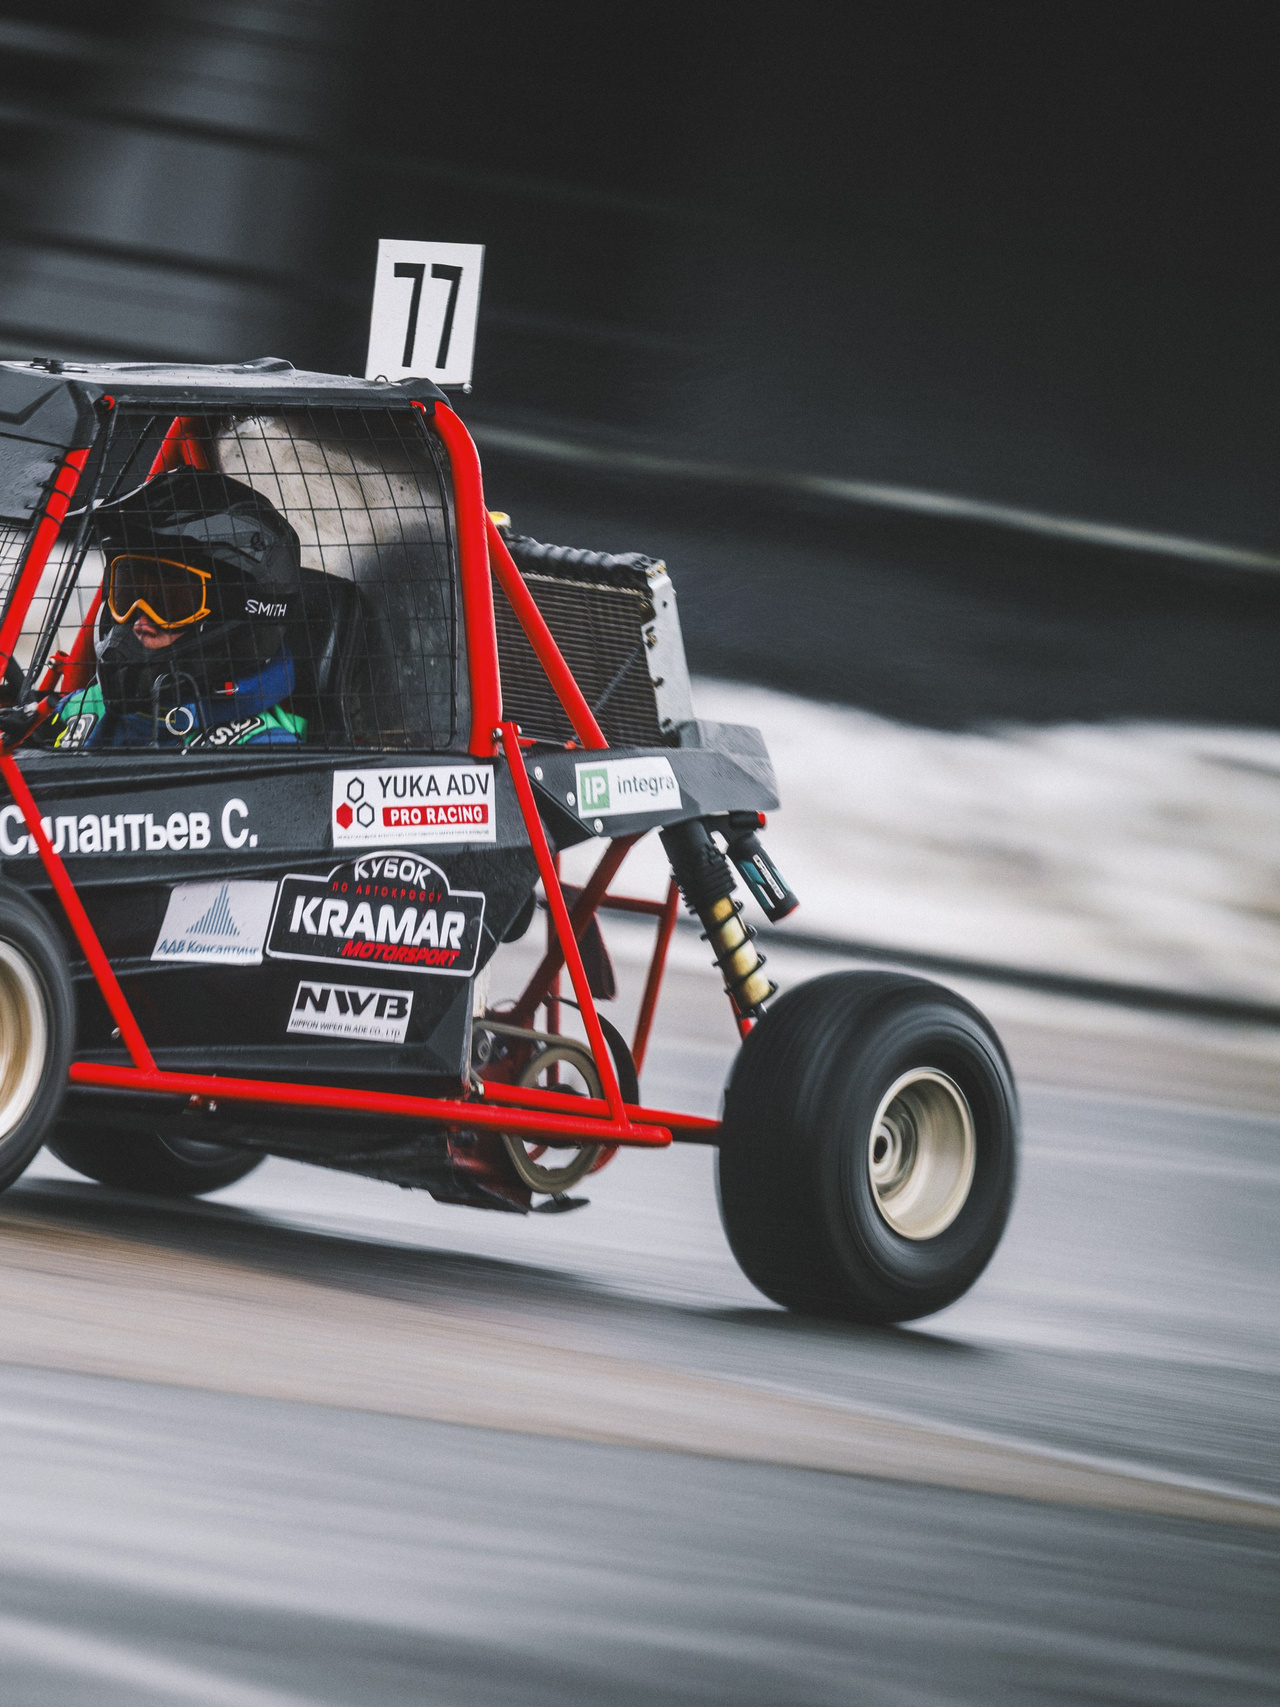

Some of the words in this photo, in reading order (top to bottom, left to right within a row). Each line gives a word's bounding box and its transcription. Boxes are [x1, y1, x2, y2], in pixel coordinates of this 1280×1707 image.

[393, 262, 463, 369] 77
[245, 599, 287, 617] SMITH
[378, 774, 441, 799] YUKA
[446, 773, 489, 796] ADV
[617, 774, 675, 797] integra
[390, 808, 422, 825] PRO
[426, 805, 483, 824] RACING
[354, 858, 431, 890] КУБОК
[332, 881, 348, 893] ПО
[355, 884, 443, 903] АВТОКРОССУ
[289, 895, 466, 950] KRAMAR
[157, 939, 186, 955] АДВ
[341, 940, 460, 967] MOTORSPORT
[295, 987, 409, 1020] NWB
[290, 1018, 319, 1030] NIPPON
[319, 1021, 343, 1032] WIPER
[344, 1023, 368, 1034] BLADE
